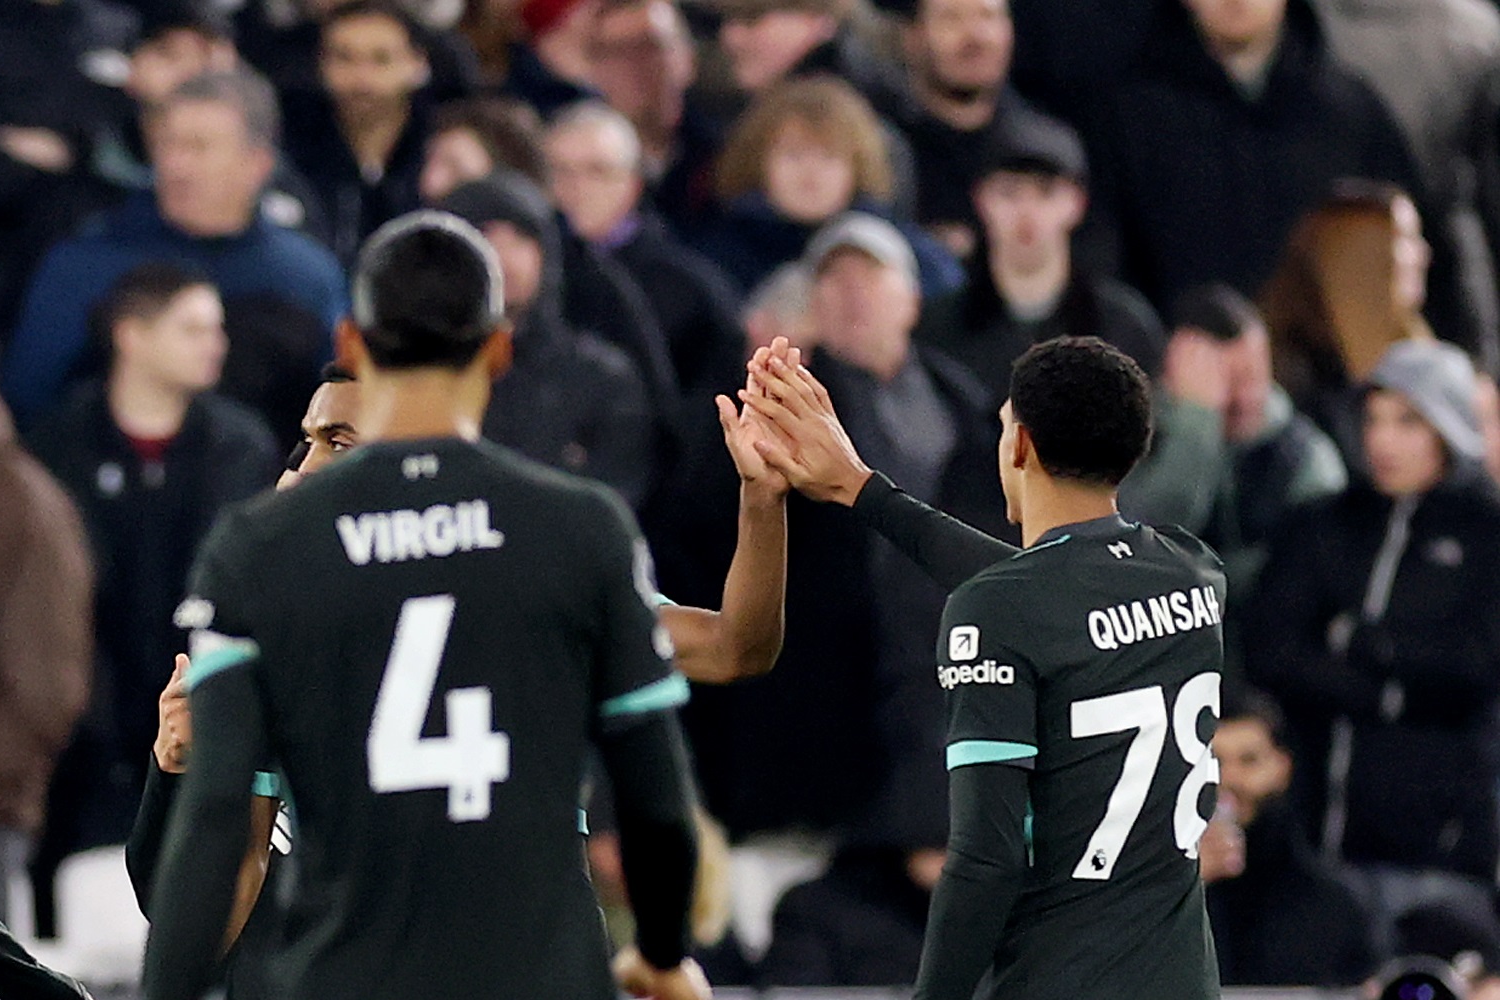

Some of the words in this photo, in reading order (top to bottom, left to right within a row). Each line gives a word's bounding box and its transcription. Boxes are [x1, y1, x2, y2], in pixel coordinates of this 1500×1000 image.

[334, 498, 505, 565] VIRGIL
[1087, 585, 1222, 650] QUANSAH
[365, 593, 510, 823] 4
[1070, 671, 1222, 880] 78
